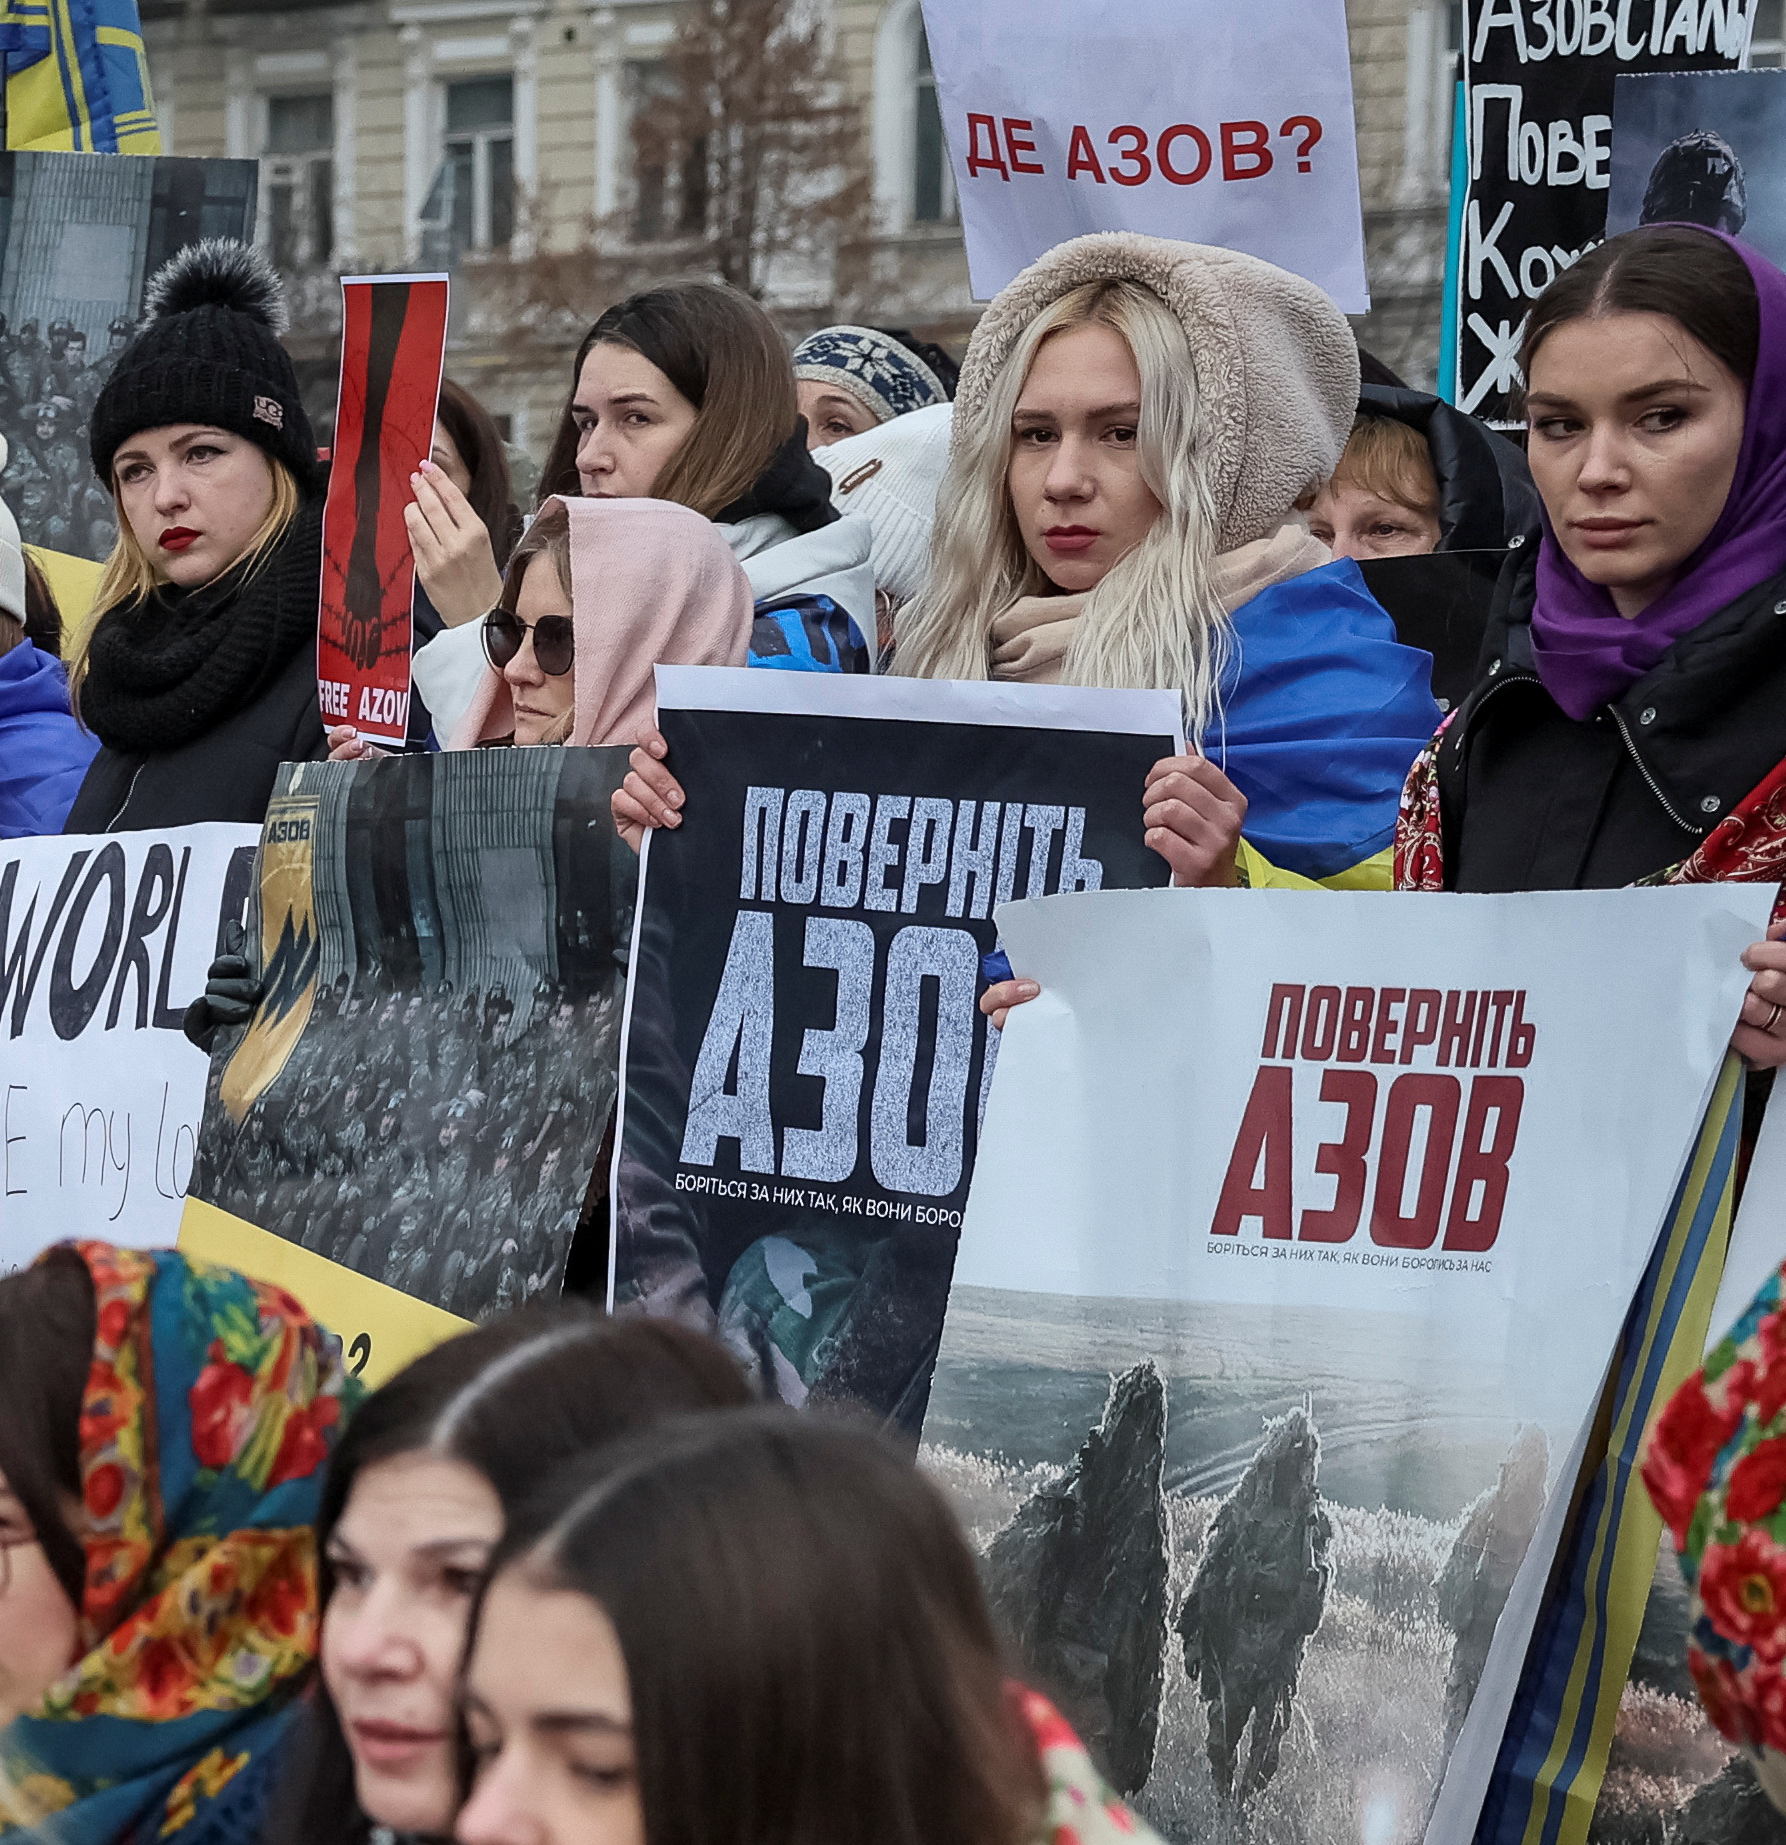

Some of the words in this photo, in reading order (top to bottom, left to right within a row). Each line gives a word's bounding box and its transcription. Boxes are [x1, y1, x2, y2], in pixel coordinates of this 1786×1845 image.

[966, 112, 1045, 182] ДЕ
[1067, 115, 1323, 187] АЗОВ?
[318, 679, 350, 717] FREE
[358, 687, 407, 726] AZOV
[739, 785, 1104, 919] ПОВЕРНІТЬ
[679, 909, 1002, 1197] АЗО
[1261, 982, 1536, 1069] ПОВЕРНІТЬ
[1210, 1065, 1525, 1253] АЗОВ
[675, 1173, 748, 1198] БОРІТЬСЯ
[750, 1183, 770, 1202] ЗА
[773, 1186, 805, 1207] НИХ
[808, 1190, 839, 1215] ТАК,
[842, 1196, 863, 1215] ЯК
[866, 1199, 912, 1221] ВОНИ
[915, 1206, 965, 1230] БОРО
[1207, 1241, 1269, 1258] БОРІТЬСЯ
[1271, 1247, 1288, 1260] ЗА
[1289, 1248, 1314, 1262] НИХ
[1316, 1249, 1340, 1266] ТАК,
[1343, 1253, 1359, 1265] ЯК
[1361, 1254, 1399, 1268] ВОНИ
[1455, 1258, 1468, 1272] ЗА
[1470, 1260, 1493, 1274] НАС
